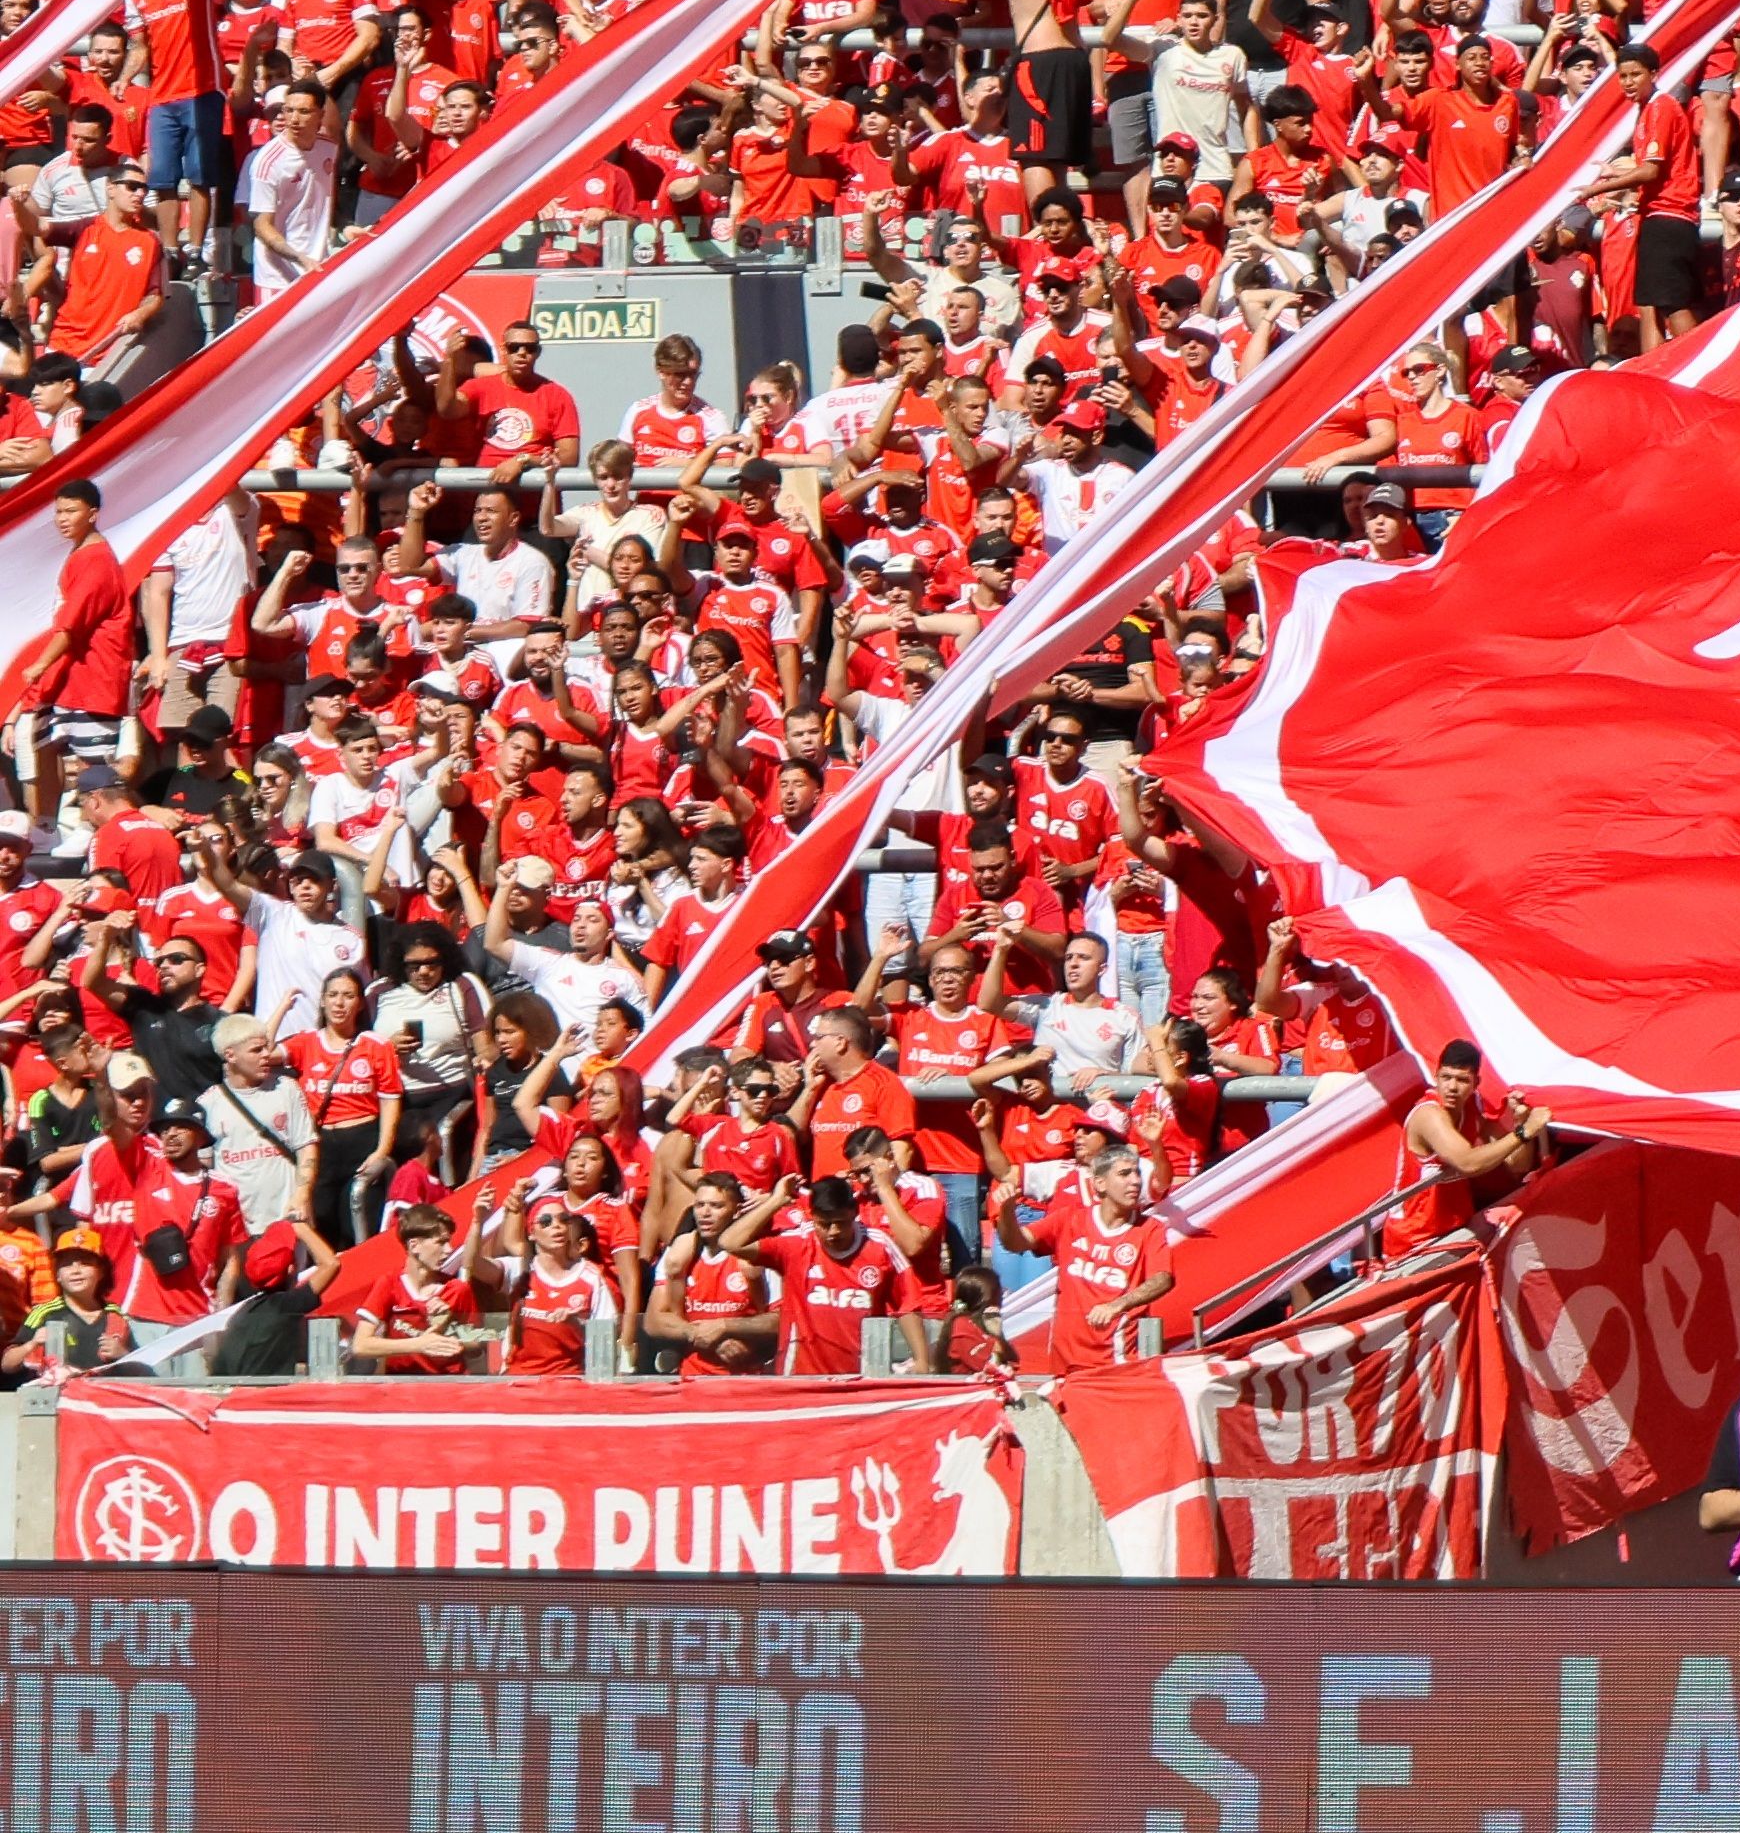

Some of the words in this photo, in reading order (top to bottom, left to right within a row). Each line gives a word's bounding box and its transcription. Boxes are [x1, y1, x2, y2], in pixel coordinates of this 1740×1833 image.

[803, 1, 852, 19] alfa
[965, 166, 1018, 183] alfa
[533, 303, 621, 338] SAÍDA
[1031, 812, 1078, 839] afa
[919, 1051, 978, 1067] Banrisul
[1067, 1260, 1127, 1286] alfa
[808, 1287, 871, 1308] alfa
[305, 1485, 565, 1573] INTER
[0, 1598, 78, 1665] ER
[89, 1599, 195, 1667] POR
[419, 1603, 530, 1672] VIVA
[540, 1604, 579, 1673] O
[594, 1606, 743, 1676] INTER
[756, 1609, 864, 1677] POR
[0, 1671, 195, 1833] IRO
[408, 1680, 867, 1833] INTEIRO
